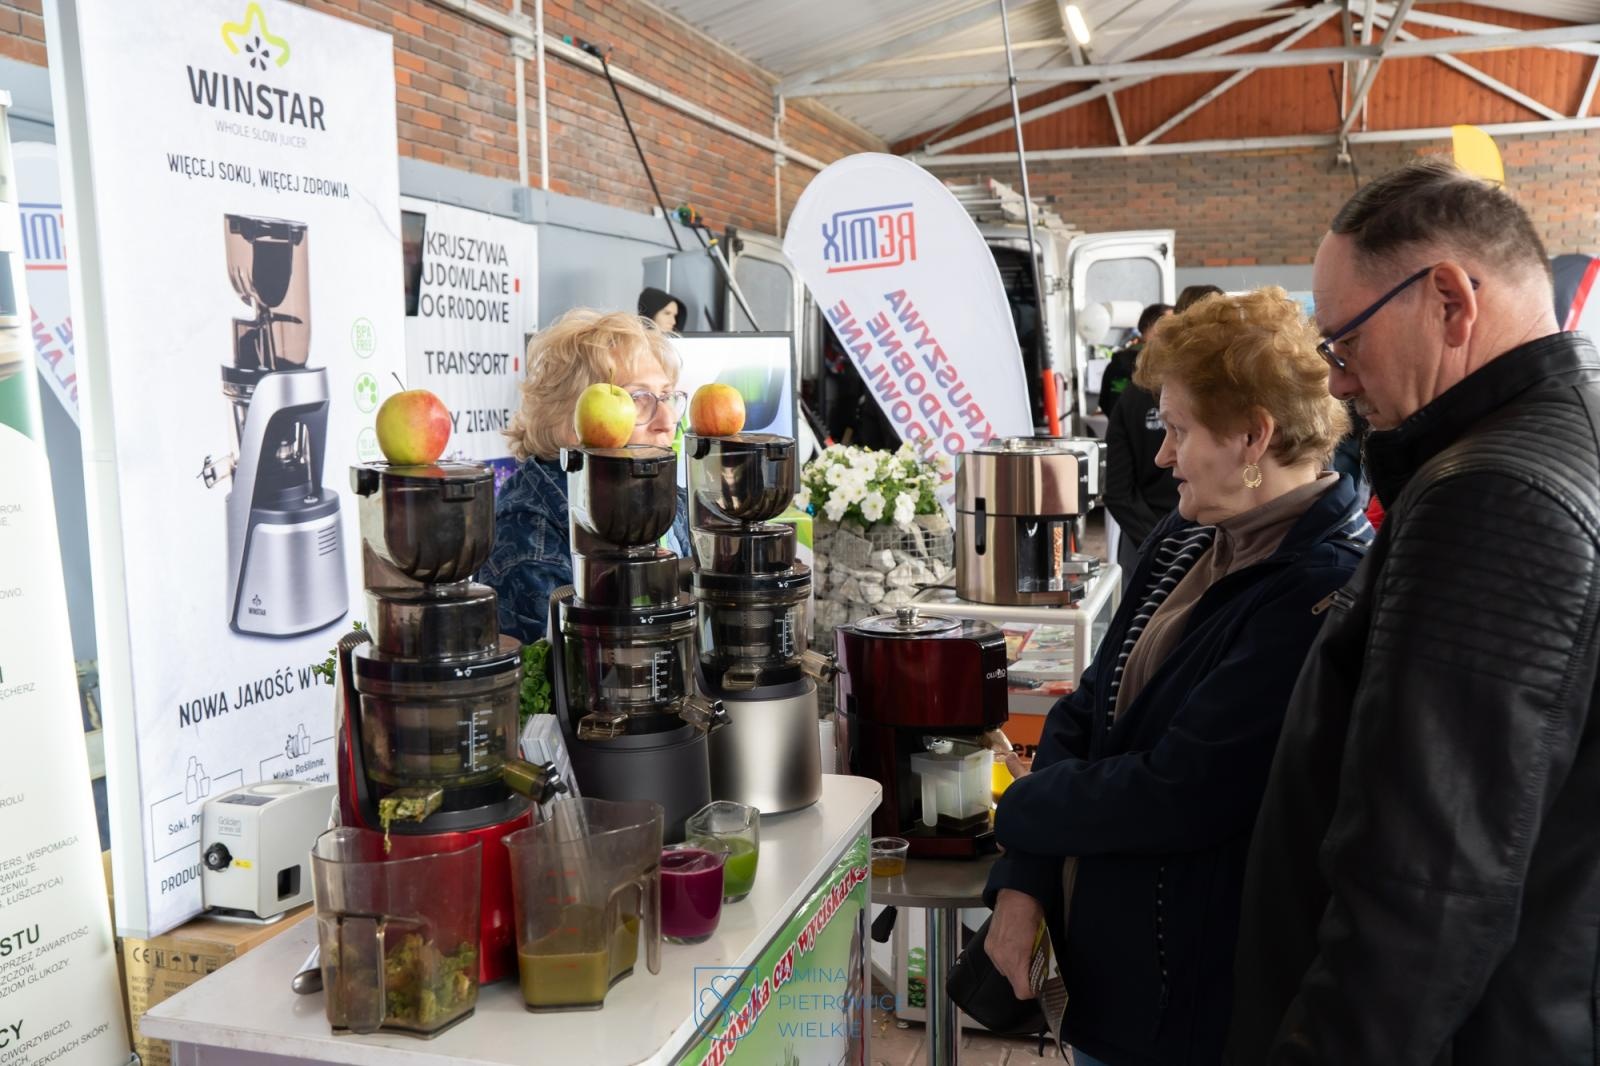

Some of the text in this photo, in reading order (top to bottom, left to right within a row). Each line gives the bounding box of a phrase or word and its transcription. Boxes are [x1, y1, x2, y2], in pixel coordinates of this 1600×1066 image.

[187, 65, 326, 131] WINSTAR
[215, 119, 308, 149] WHOLE SLOW JUICER
[167, 153, 350, 199] WIĘCEJ SOKU, WIĘCEJ ZDROWIA
[426, 231, 509, 266] KRUSZYWA
[421, 293, 509, 323] OGRODOWE
[424, 351, 509, 375] TRANSPORT
[179, 691, 229, 728] NOWA
[234, 666, 294, 710] JAKOŚĆ
[772, 942, 796, 992] czy
[30, 1038, 80, 1066] FEKCJACH
